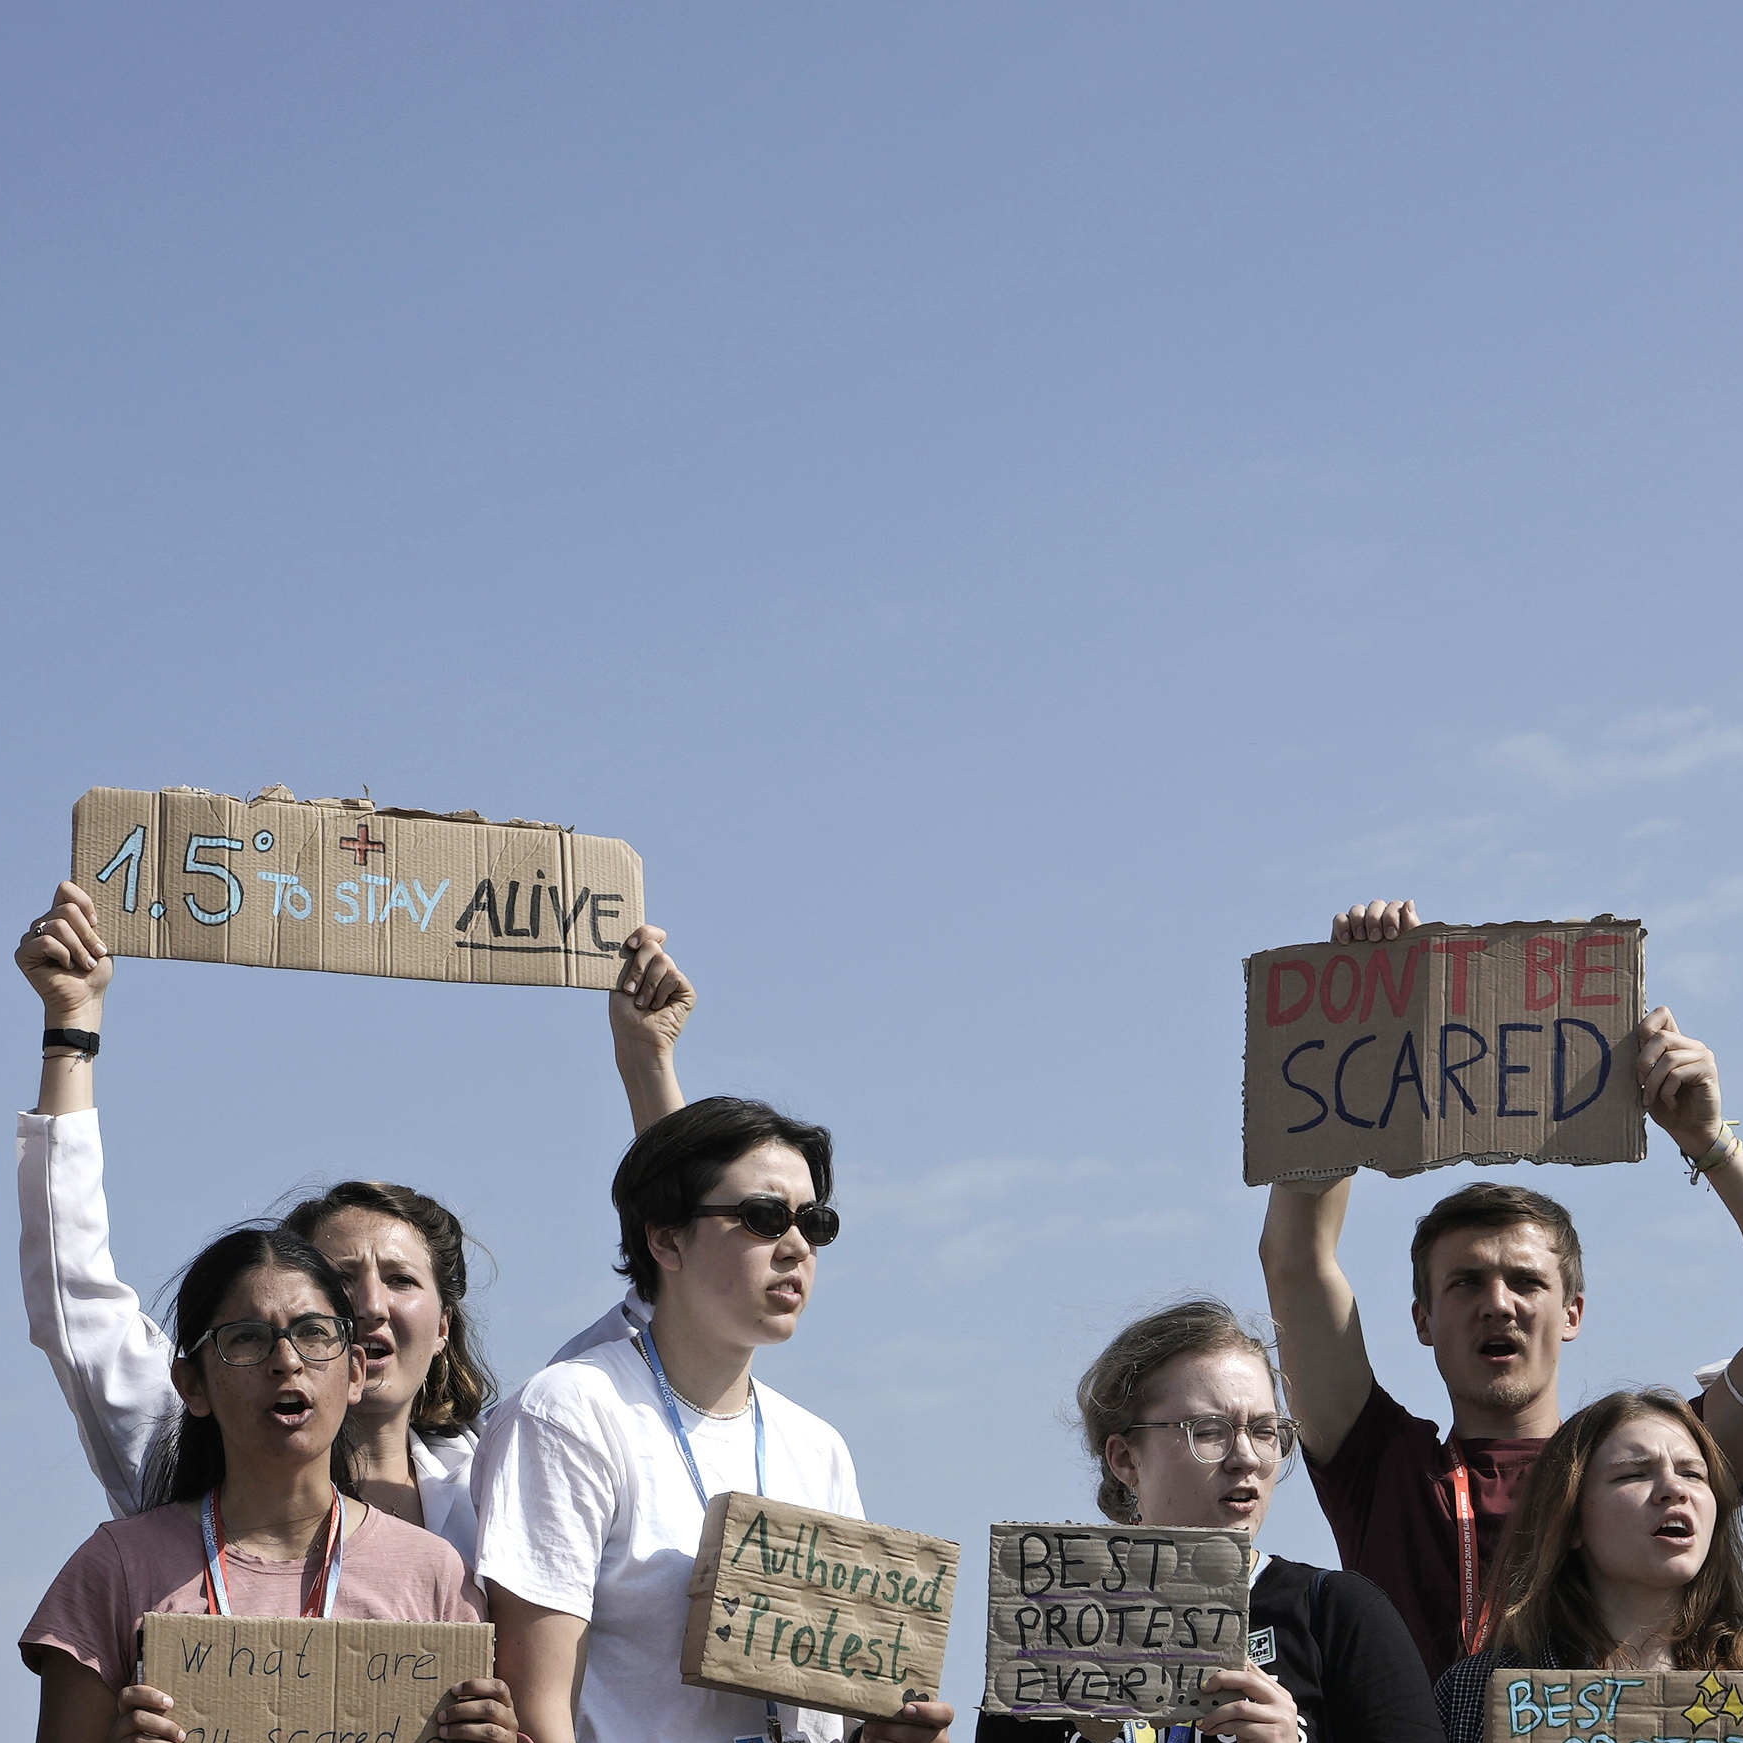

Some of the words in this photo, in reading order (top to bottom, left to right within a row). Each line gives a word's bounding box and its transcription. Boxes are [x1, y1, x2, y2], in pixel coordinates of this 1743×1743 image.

[334, 874, 450, 932] STAY
[1266, 938, 1488, 1027] DON'T
[1524, 934, 1625, 1010] BE
[1281, 1017, 1612, 1133] SCARED
[657, 1371, 674, 1408] UNFCCC
[202, 1513, 213, 1547] UNFCCC
[731, 1510, 948, 1613] Authorised
[1019, 1533, 1175, 1595] BEST
[1465, 1559, 1474, 1580] SPACE
[1466, 1580, 1474, 1594] FOR
[743, 1591, 911, 1684] Protest
[1016, 1604, 1243, 1650] PROTEST
[367, 1652, 438, 1683] are
[1507, 1678, 1645, 1738] BEST
